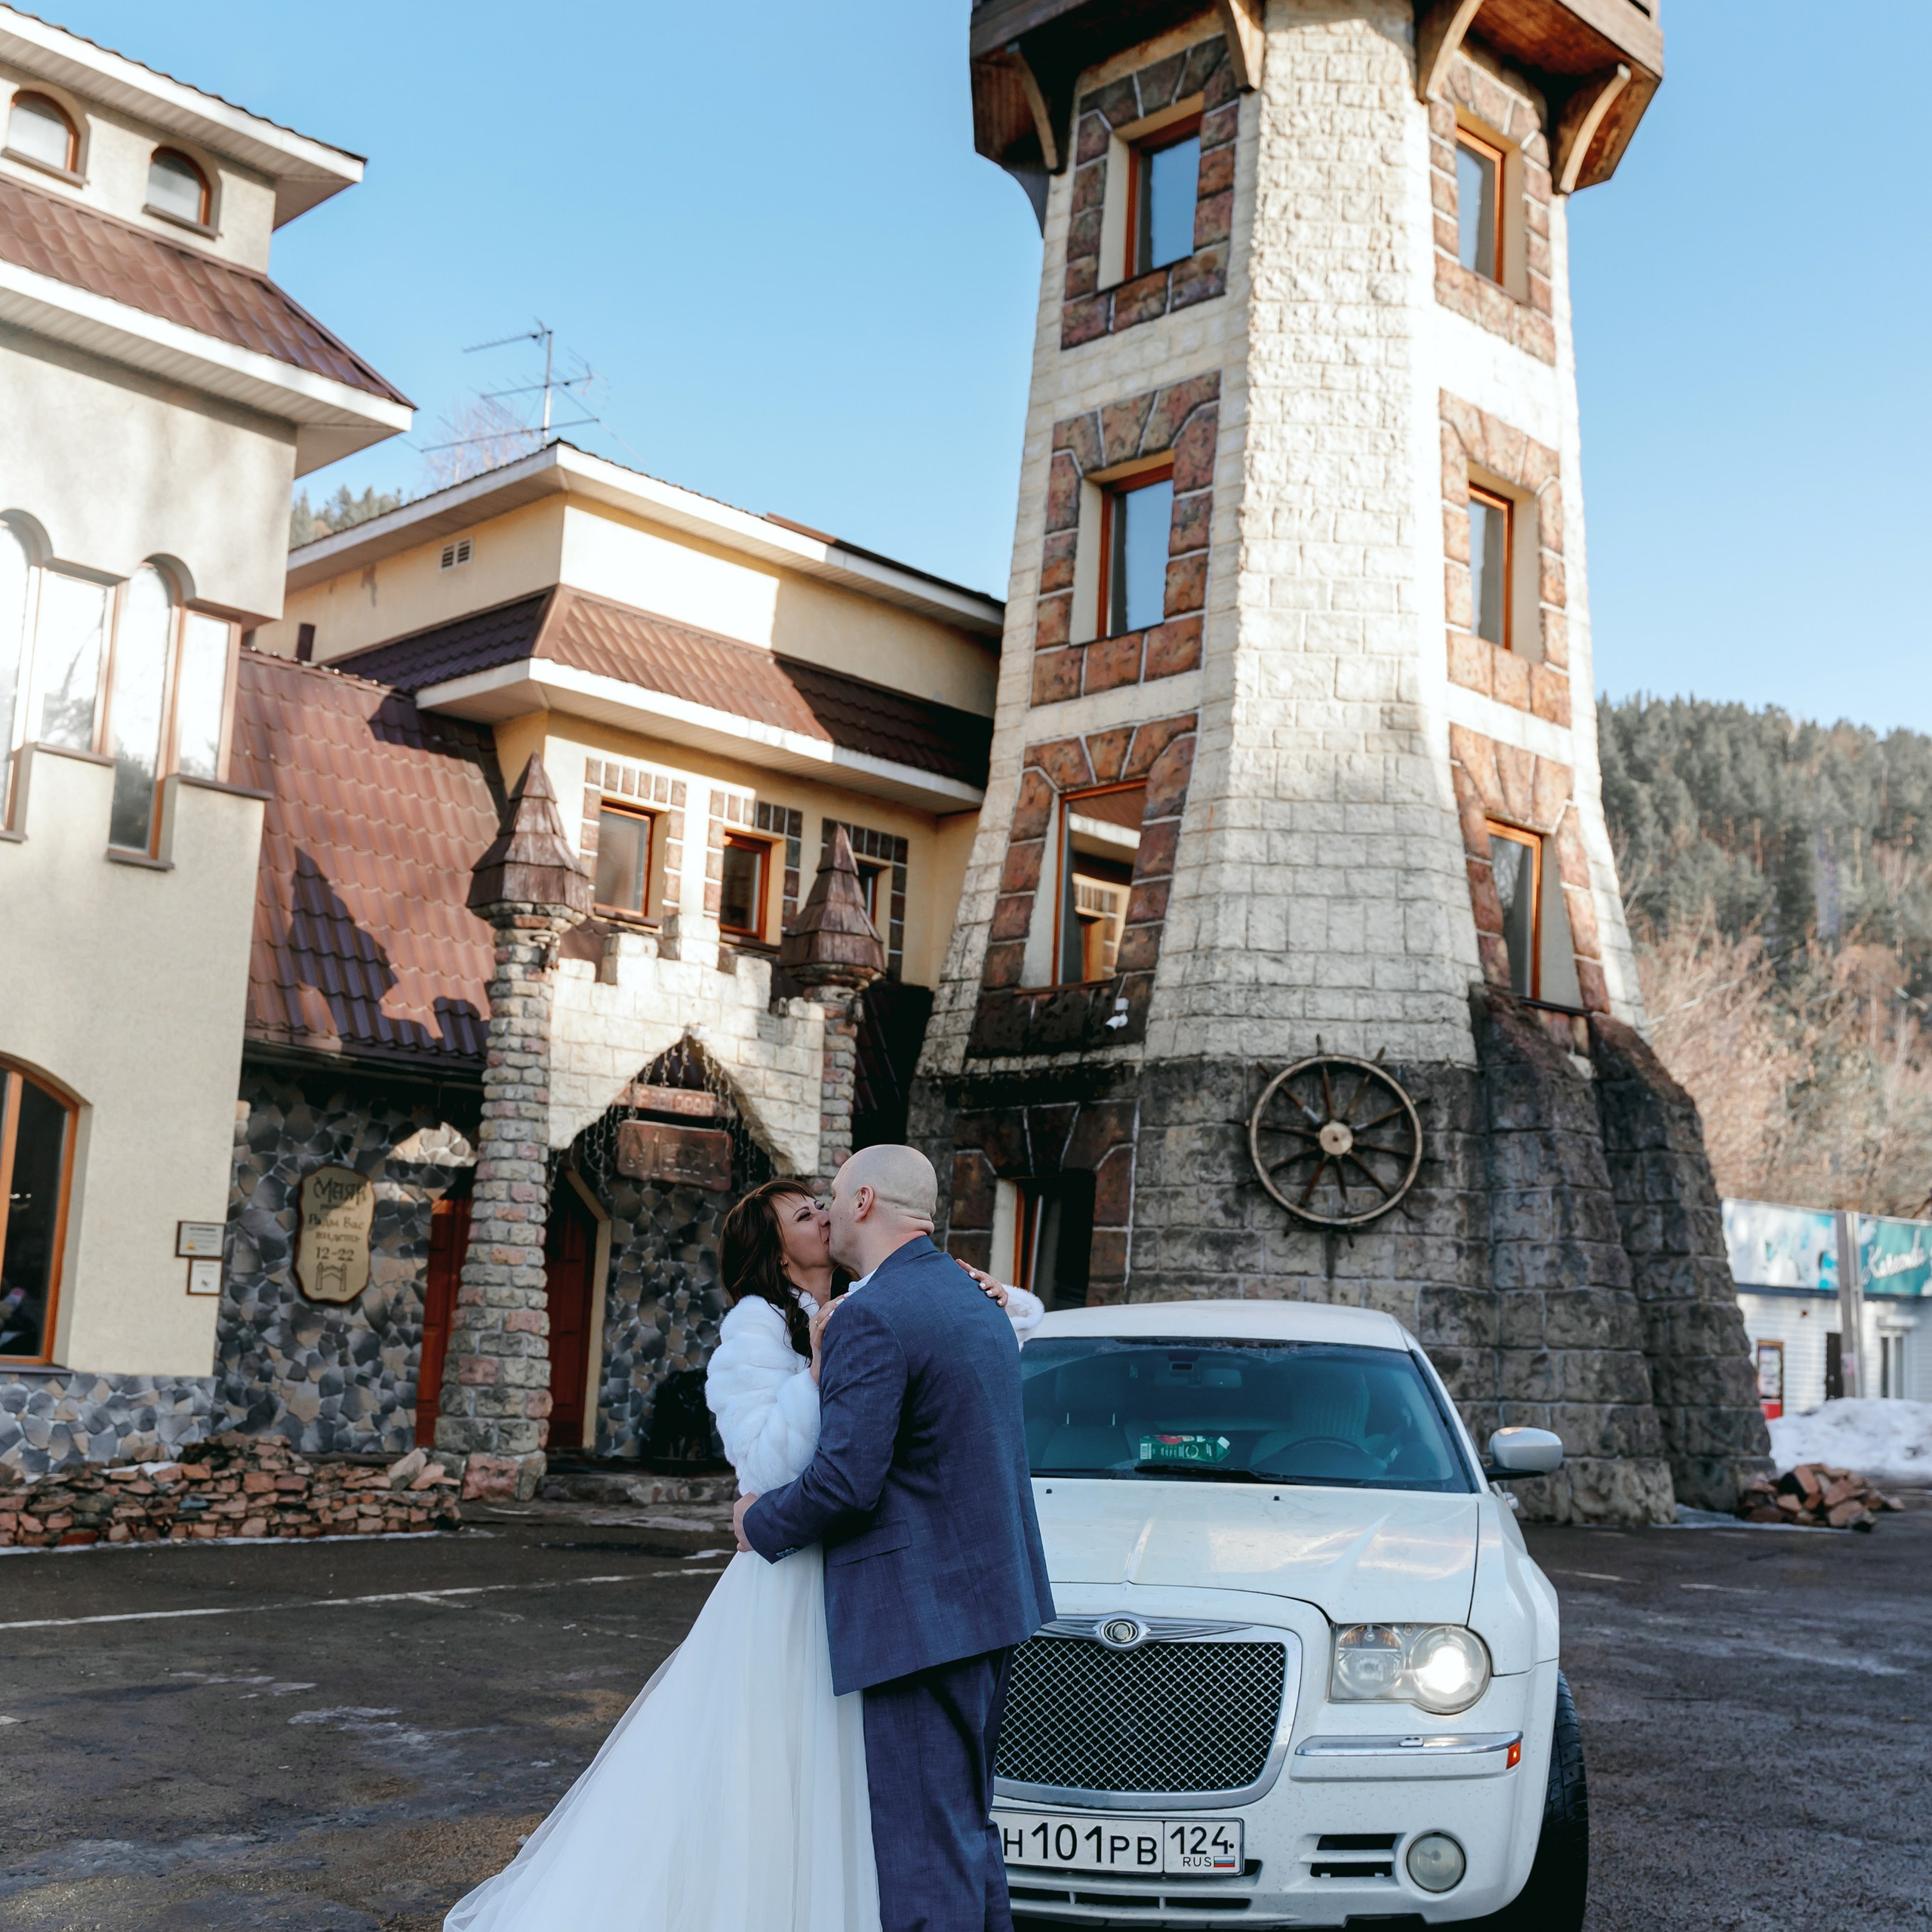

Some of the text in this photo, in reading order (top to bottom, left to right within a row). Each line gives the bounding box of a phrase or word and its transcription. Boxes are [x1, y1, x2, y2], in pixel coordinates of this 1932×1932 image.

[315, 1247, 355, 1262] 12-22
[1170, 1826, 1229, 1855] 124
[1183, 1856, 1212, 1867] RUS
